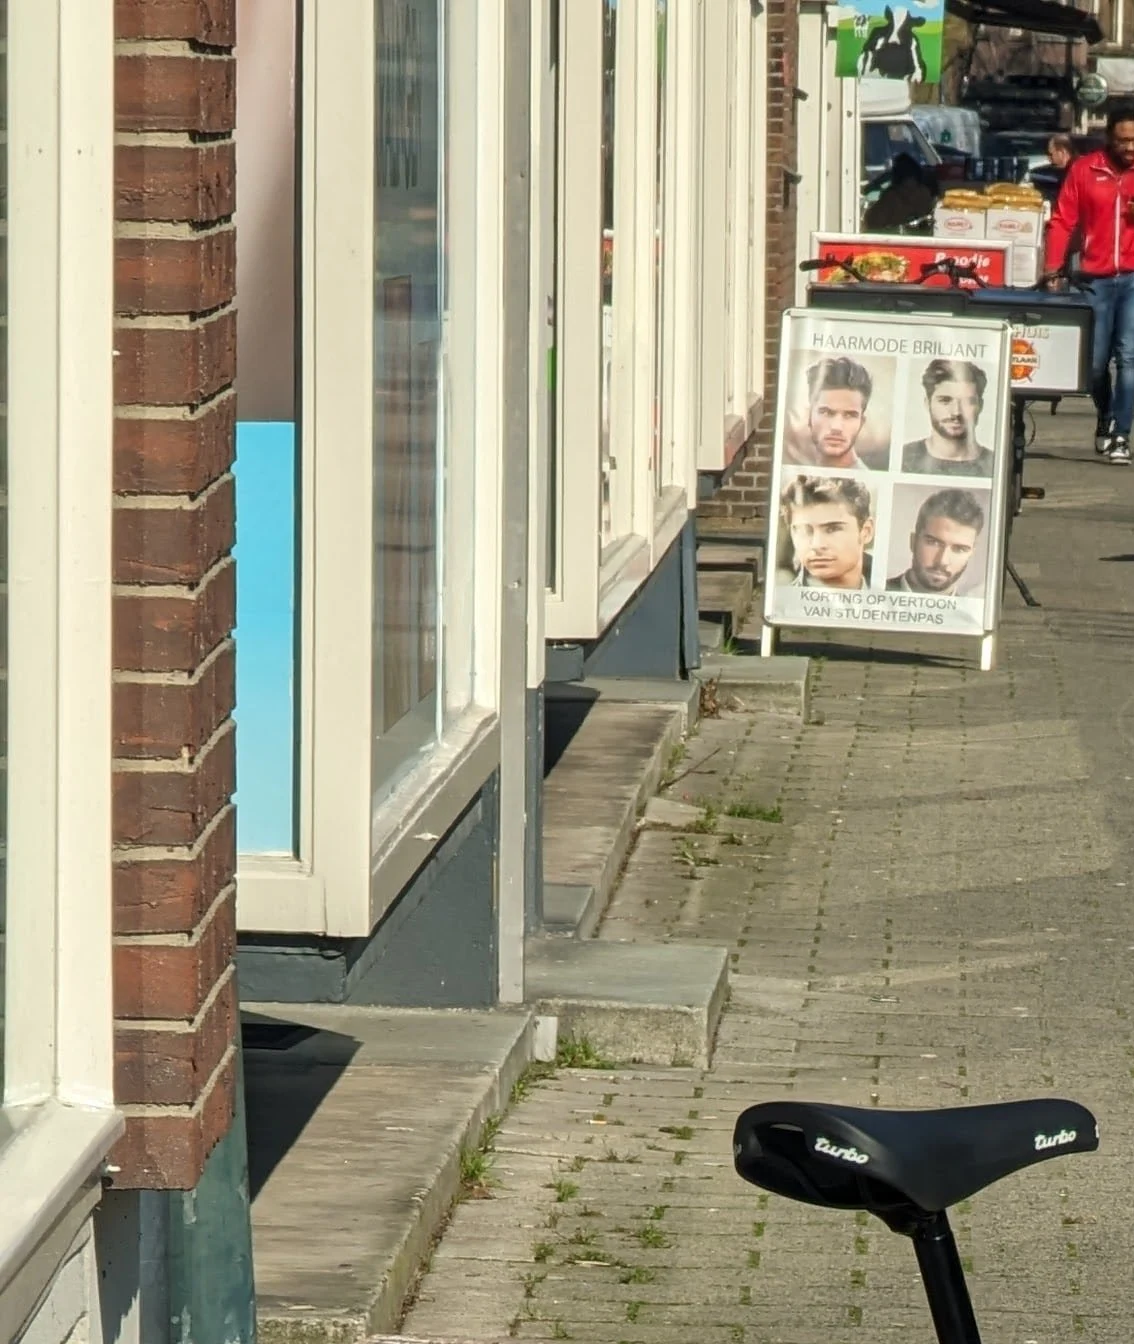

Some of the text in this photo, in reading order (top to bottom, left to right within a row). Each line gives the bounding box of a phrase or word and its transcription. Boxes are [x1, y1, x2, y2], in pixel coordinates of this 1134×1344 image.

[812, 332, 909, 354] HAARMODE
[800, 590, 957, 610] KORTING OP VERTOON
[803, 606, 944, 625] VAN STUDENTENPAS
[814, 1136, 870, 1165] turbo
[1034, 1129, 1077, 1151] turbo
